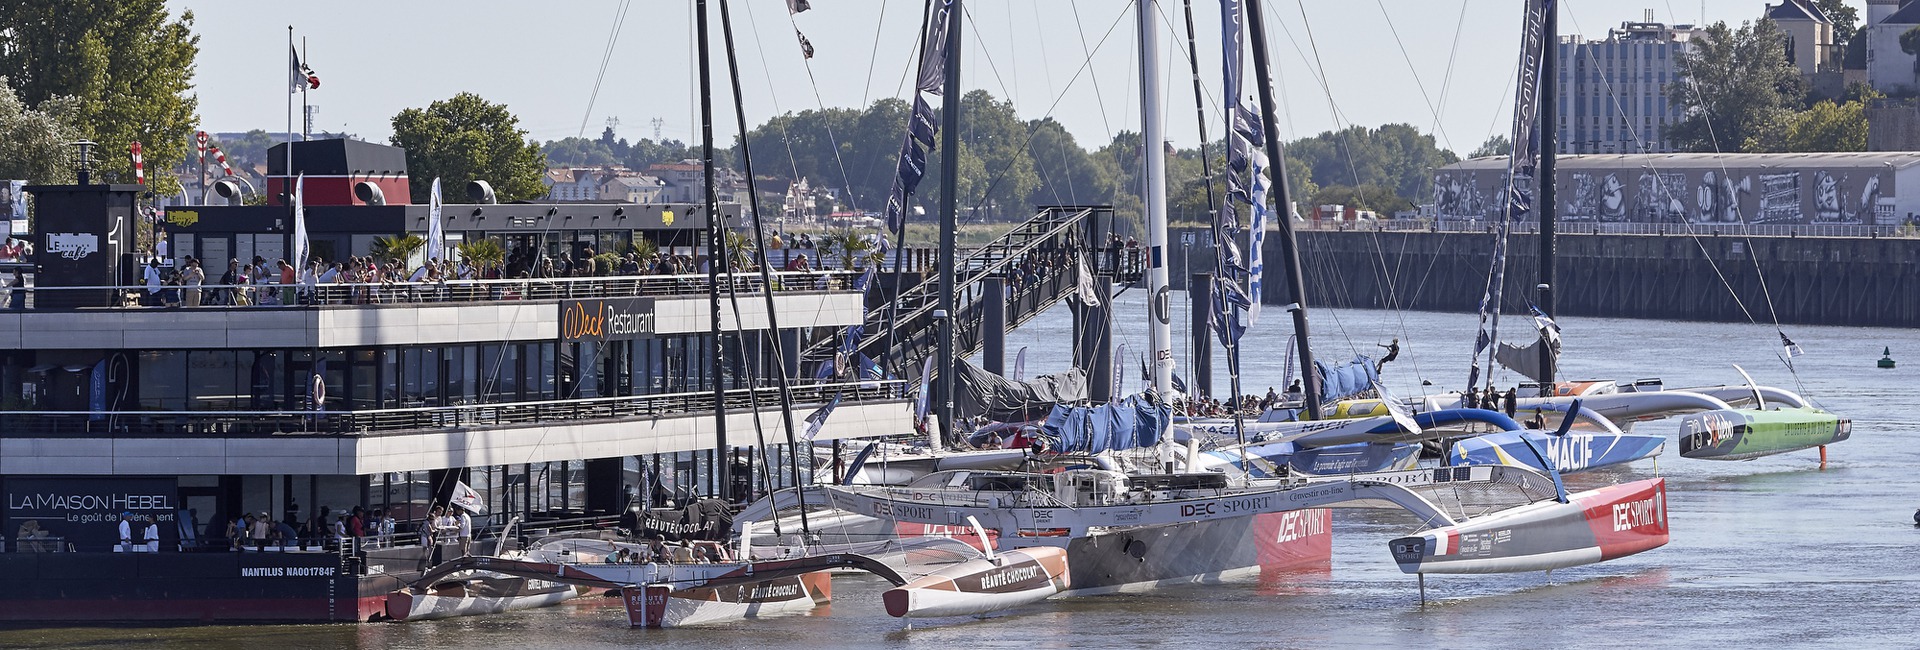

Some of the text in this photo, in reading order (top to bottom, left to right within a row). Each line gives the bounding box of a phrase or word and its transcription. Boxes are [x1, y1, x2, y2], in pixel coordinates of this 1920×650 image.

[61, 246, 88, 260] café
[608, 305, 654, 334] Restaurant
[1547, 434, 1594, 471] MACIF
[9, 493, 174, 510] LA MAISON HEBEL
[1181, 497, 1271, 517] IDEC SPORT
[67, 512, 79, 522] Le
[81, 512, 101, 523] goût
[105, 513, 117, 522] de
[897, 506, 934, 519] SPORT
[1612, 498, 1654, 532] IDEC SPORT
[1298, 508, 1326, 538] SPORT
[1396, 543, 1420, 554] IDEC
[242, 567, 336, 577] NANTILUS NA001784F
[981, 565, 1037, 590] RÉAUTÉ CHOCOLAT
[750, 583, 799, 599] RÉAUTÉ CHOCOLAT
